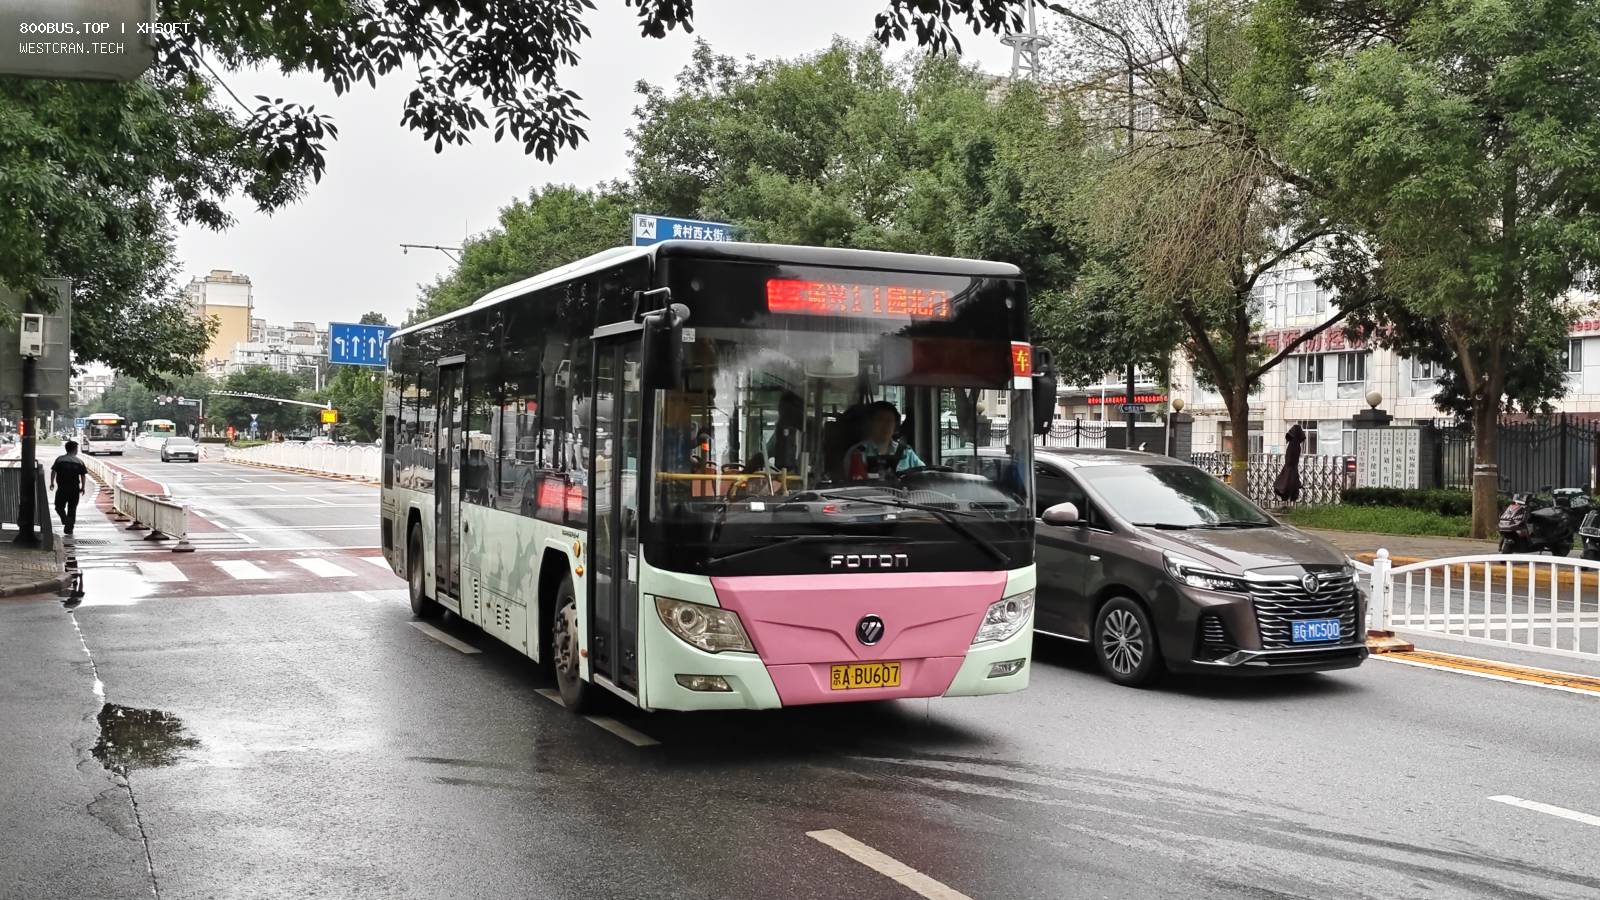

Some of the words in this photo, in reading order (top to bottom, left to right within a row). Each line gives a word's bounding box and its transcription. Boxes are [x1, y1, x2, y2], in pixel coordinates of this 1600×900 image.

[672, 223, 724, 241] 黄村西大街
[830, 554, 909, 568] FOTON
